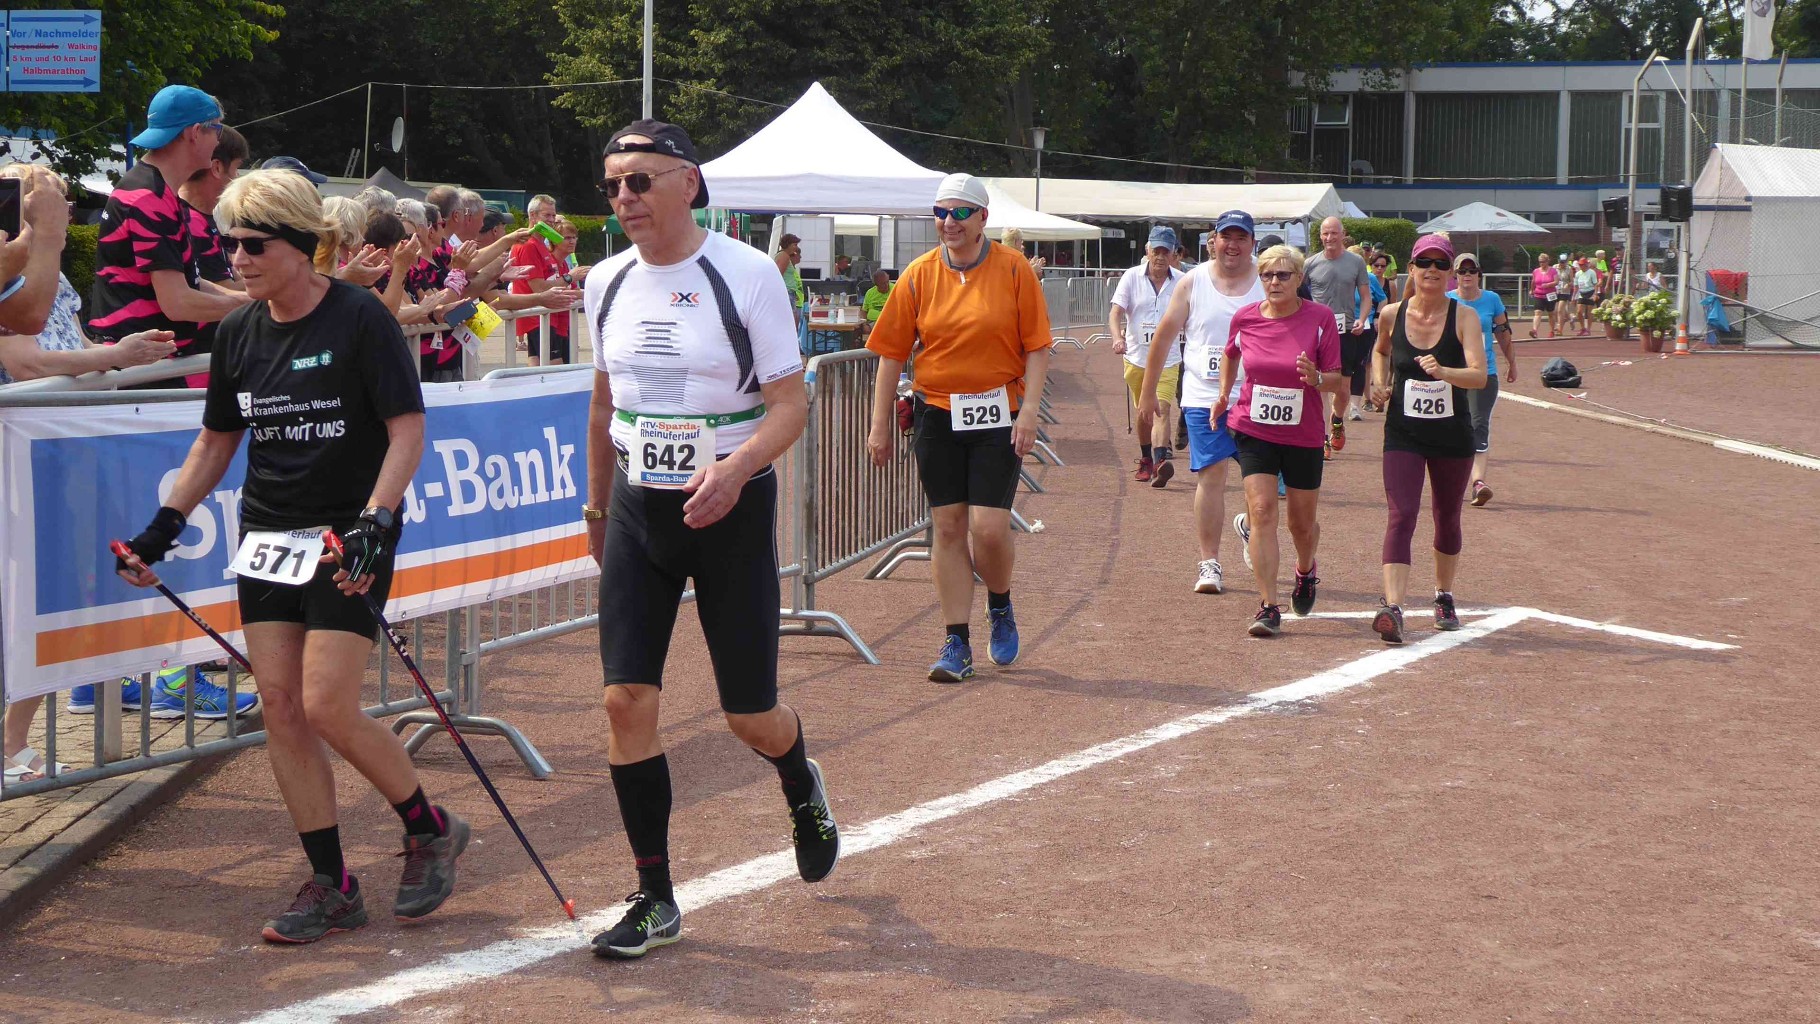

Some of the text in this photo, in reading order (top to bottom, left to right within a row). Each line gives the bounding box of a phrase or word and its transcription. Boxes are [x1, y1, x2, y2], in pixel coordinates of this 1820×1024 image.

[11, 29, 27, 38] Vor
[35, 29, 99, 38] Nachmelder
[67, 42, 98, 51] Walking
[23, 66, 86, 75] Halbmarathon
[293, 356, 318, 370] NRZ
[253, 394, 291, 405] Evangelisches
[253, 397, 342, 417] Krankenhaus Wesel
[1412, 398, 1446, 415] 426
[962, 404, 1001, 426] 529
[1259, 403, 1293, 422] 308
[285, 416, 314, 441] MIT
[316, 420, 346, 438] UNS
[640, 428, 701, 441] Rheinuferlauf
[642, 442, 696, 471] 642
[249, 542, 307, 577] 571
